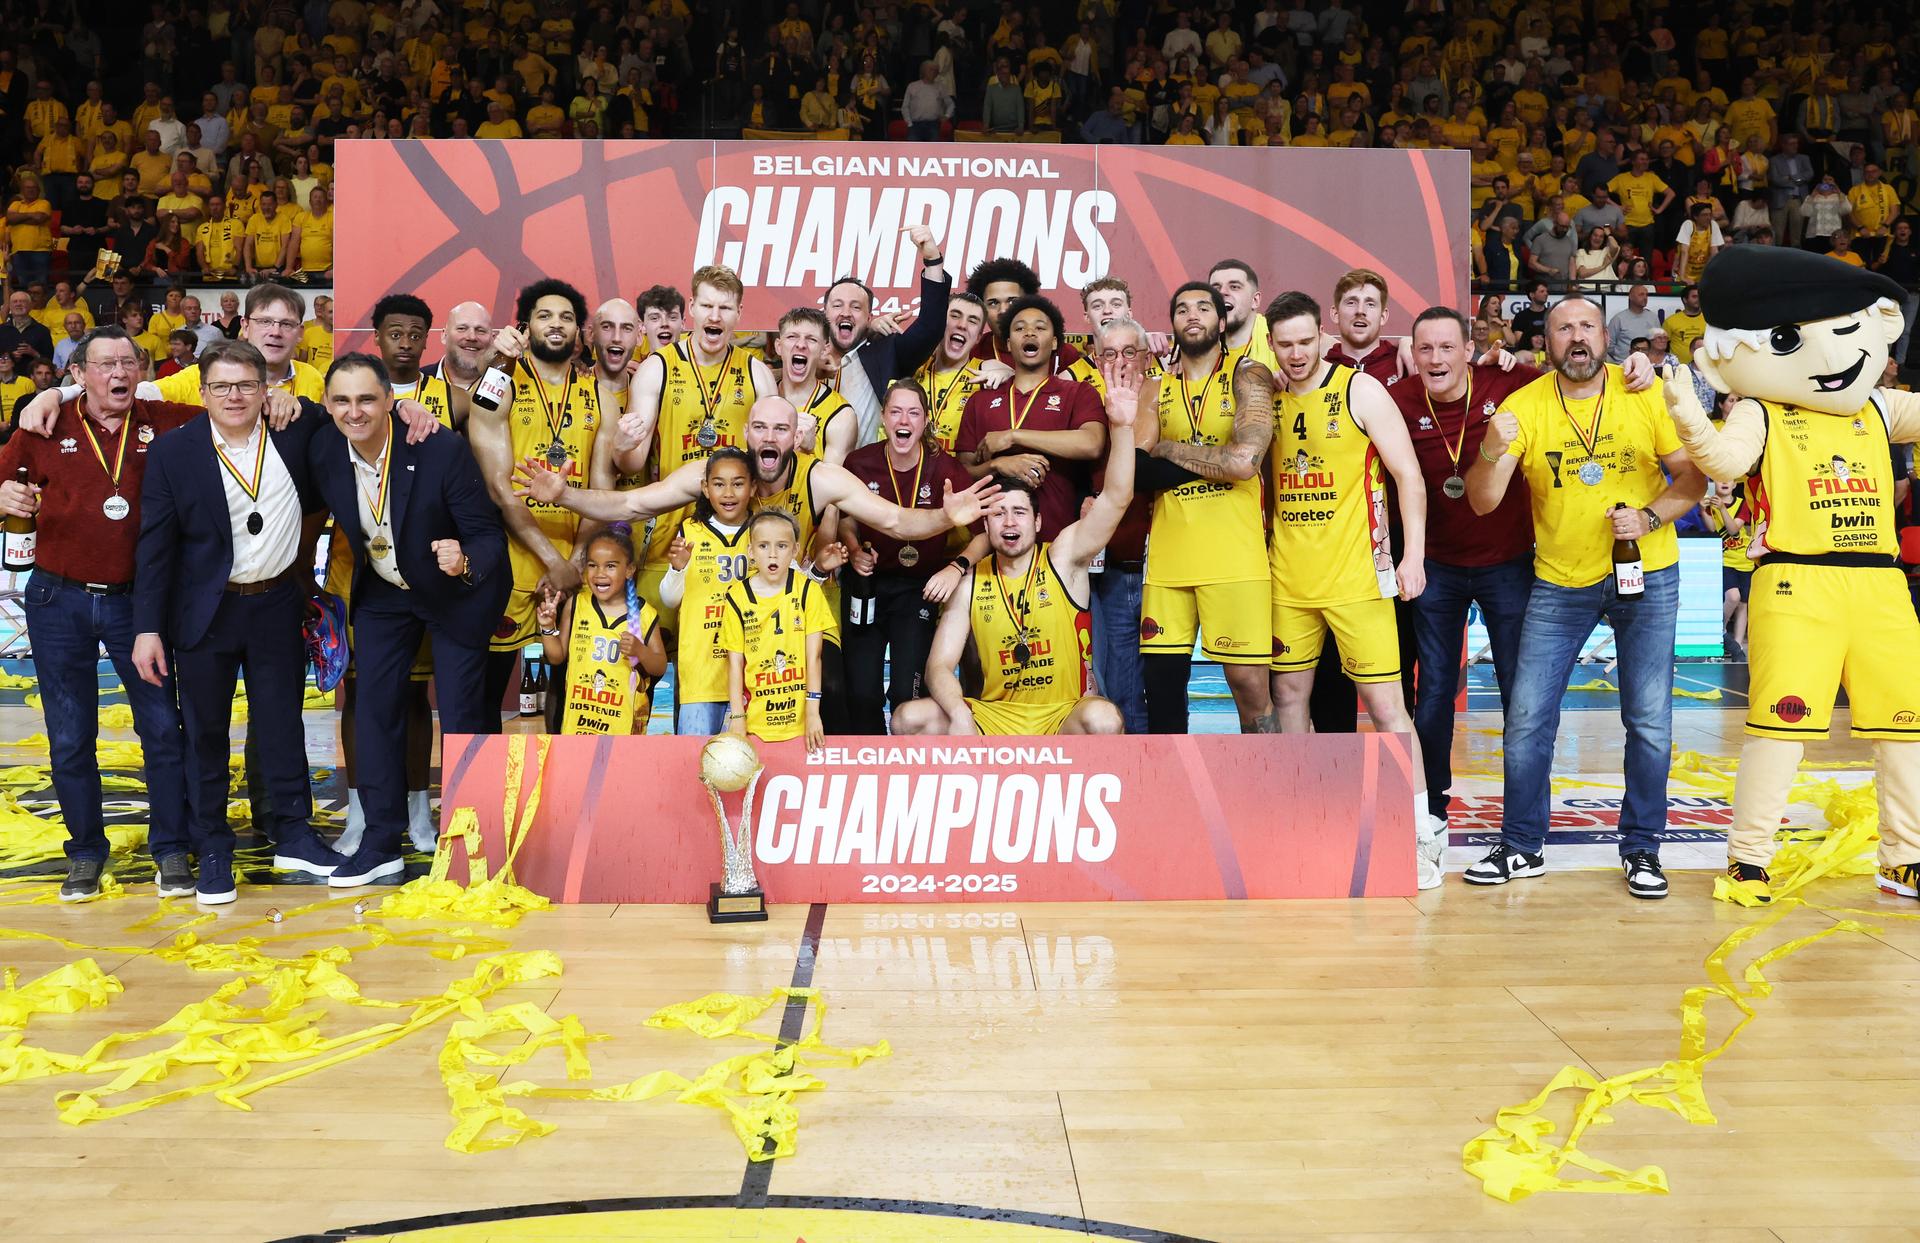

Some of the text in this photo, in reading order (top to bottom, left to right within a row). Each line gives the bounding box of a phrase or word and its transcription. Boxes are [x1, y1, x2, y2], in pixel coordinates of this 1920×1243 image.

[752, 155, 1060, 179] BELGIAN NATIONAL
[692, 185, 1118, 290] CHAMPIONS
[481, 381, 505, 399] FILO
[1292, 412, 1307, 441] 4
[1279, 471, 1335, 490] FILOU
[1807, 478, 1878, 497] FILOU
[1279, 491, 1338, 502] OOSTENDE
[1809, 497, 1881, 510] OOSTENDE
[1281, 509, 1335, 522] Coretec
[1831, 511, 1875, 529] bwin
[1832, 533, 1878, 542] CASINO
[8, 548, 35, 559] FILO
[716, 553, 748, 583] 30
[1619, 576, 1644, 588] FILO
[770, 608, 784, 635] 1
[591, 636, 622, 665] 30
[755, 667, 805, 687] FILOU
[571, 684, 624, 707] FILOU
[755, 683, 807, 698] OOSTENDE
[569, 702, 622, 718] OOSTENDE
[765, 696, 796, 712] bwin
[576, 714, 610, 732] bwin
[1895, 715, 1915, 723] P&V
[805, 746, 1073, 765] BELGIAN NATIONAL
[755, 773, 1122, 865] CHAMPIONS
[861, 874, 1018, 893] 2024-2025
